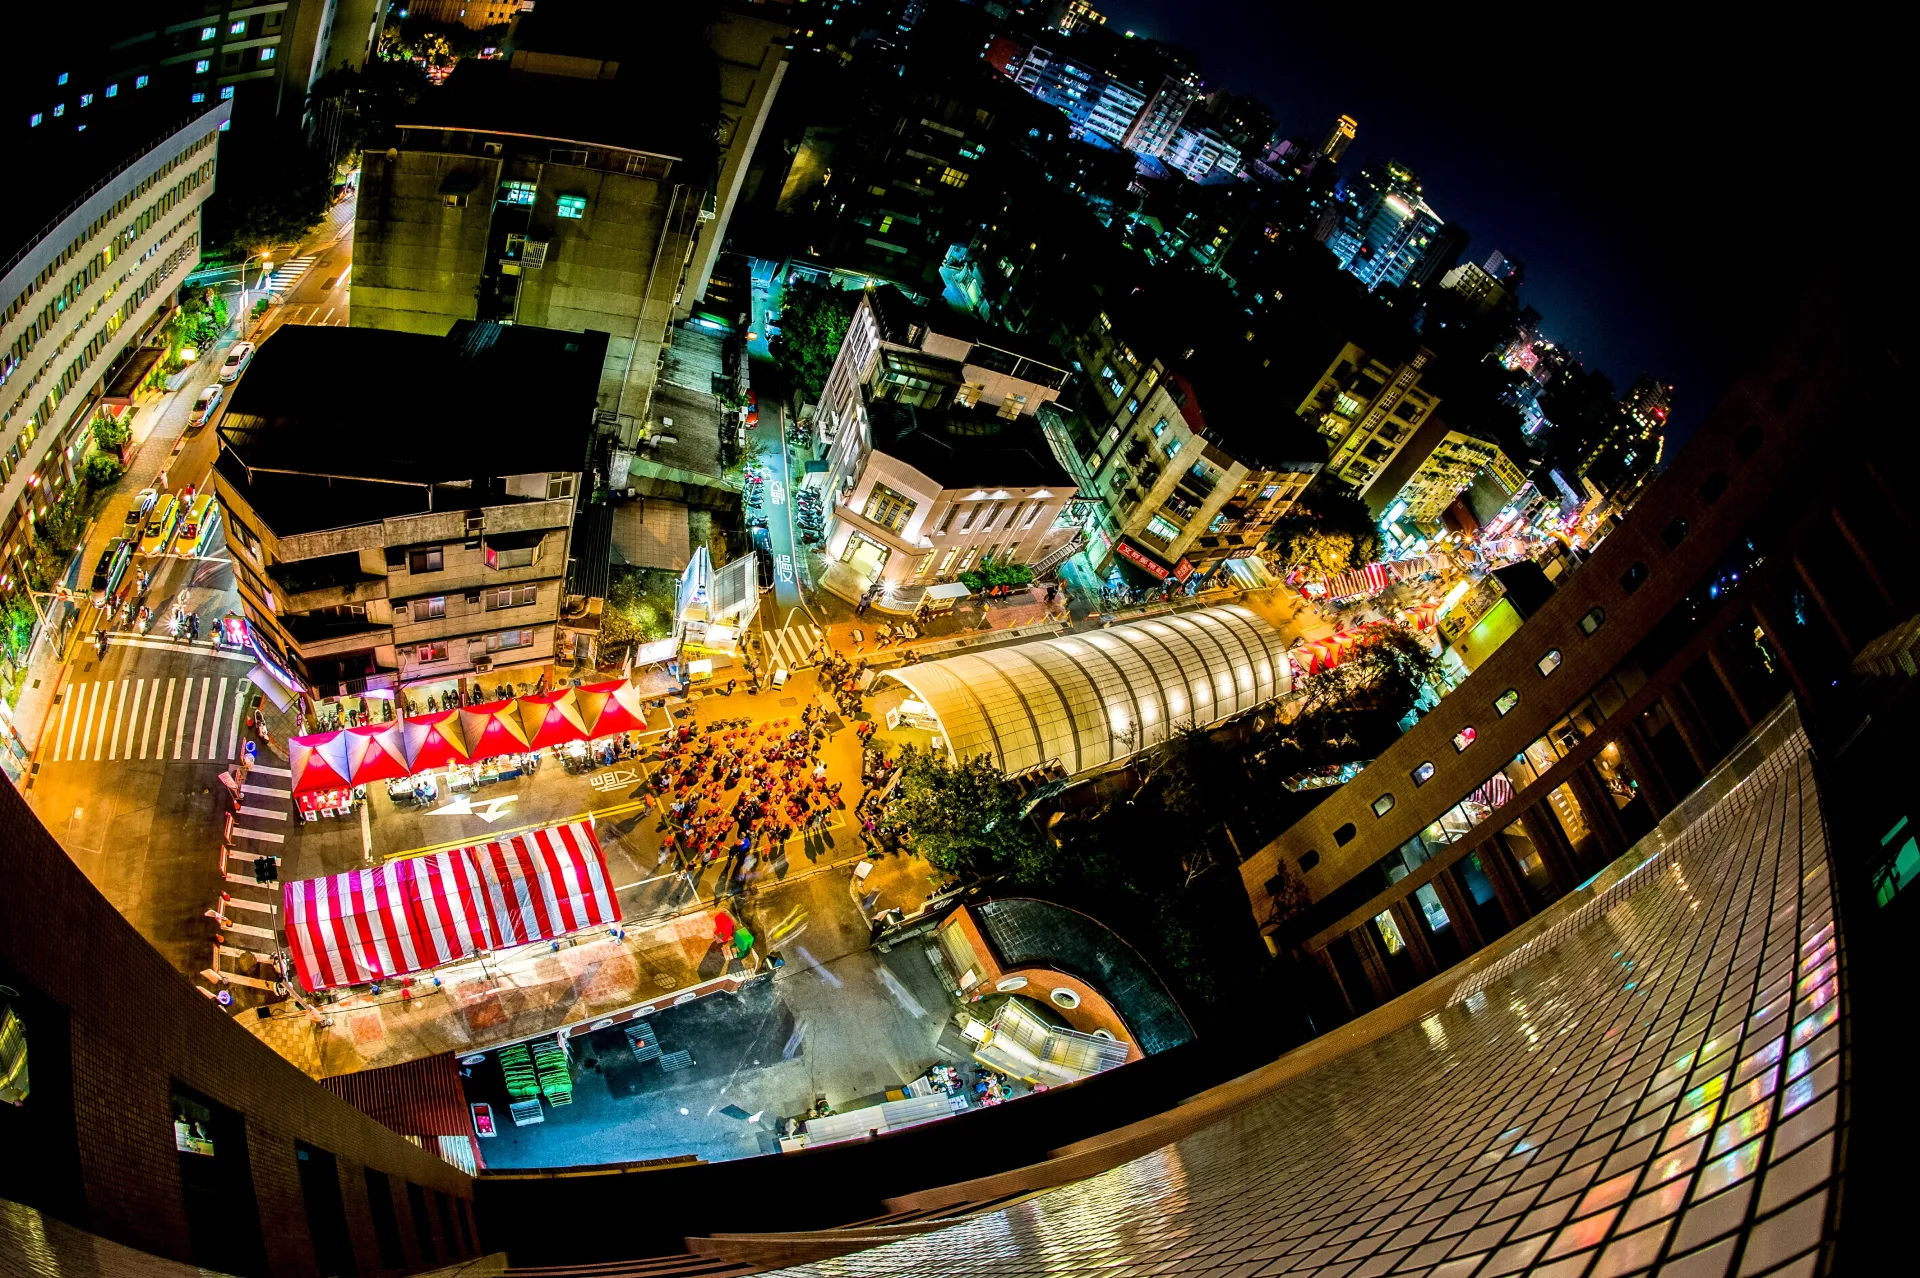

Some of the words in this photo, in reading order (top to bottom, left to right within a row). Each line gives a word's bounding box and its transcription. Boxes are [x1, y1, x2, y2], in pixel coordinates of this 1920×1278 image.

[770, 480, 785, 505] 慢
[776, 553, 793, 584] 慢
[590, 768, 640, 792] 慢
